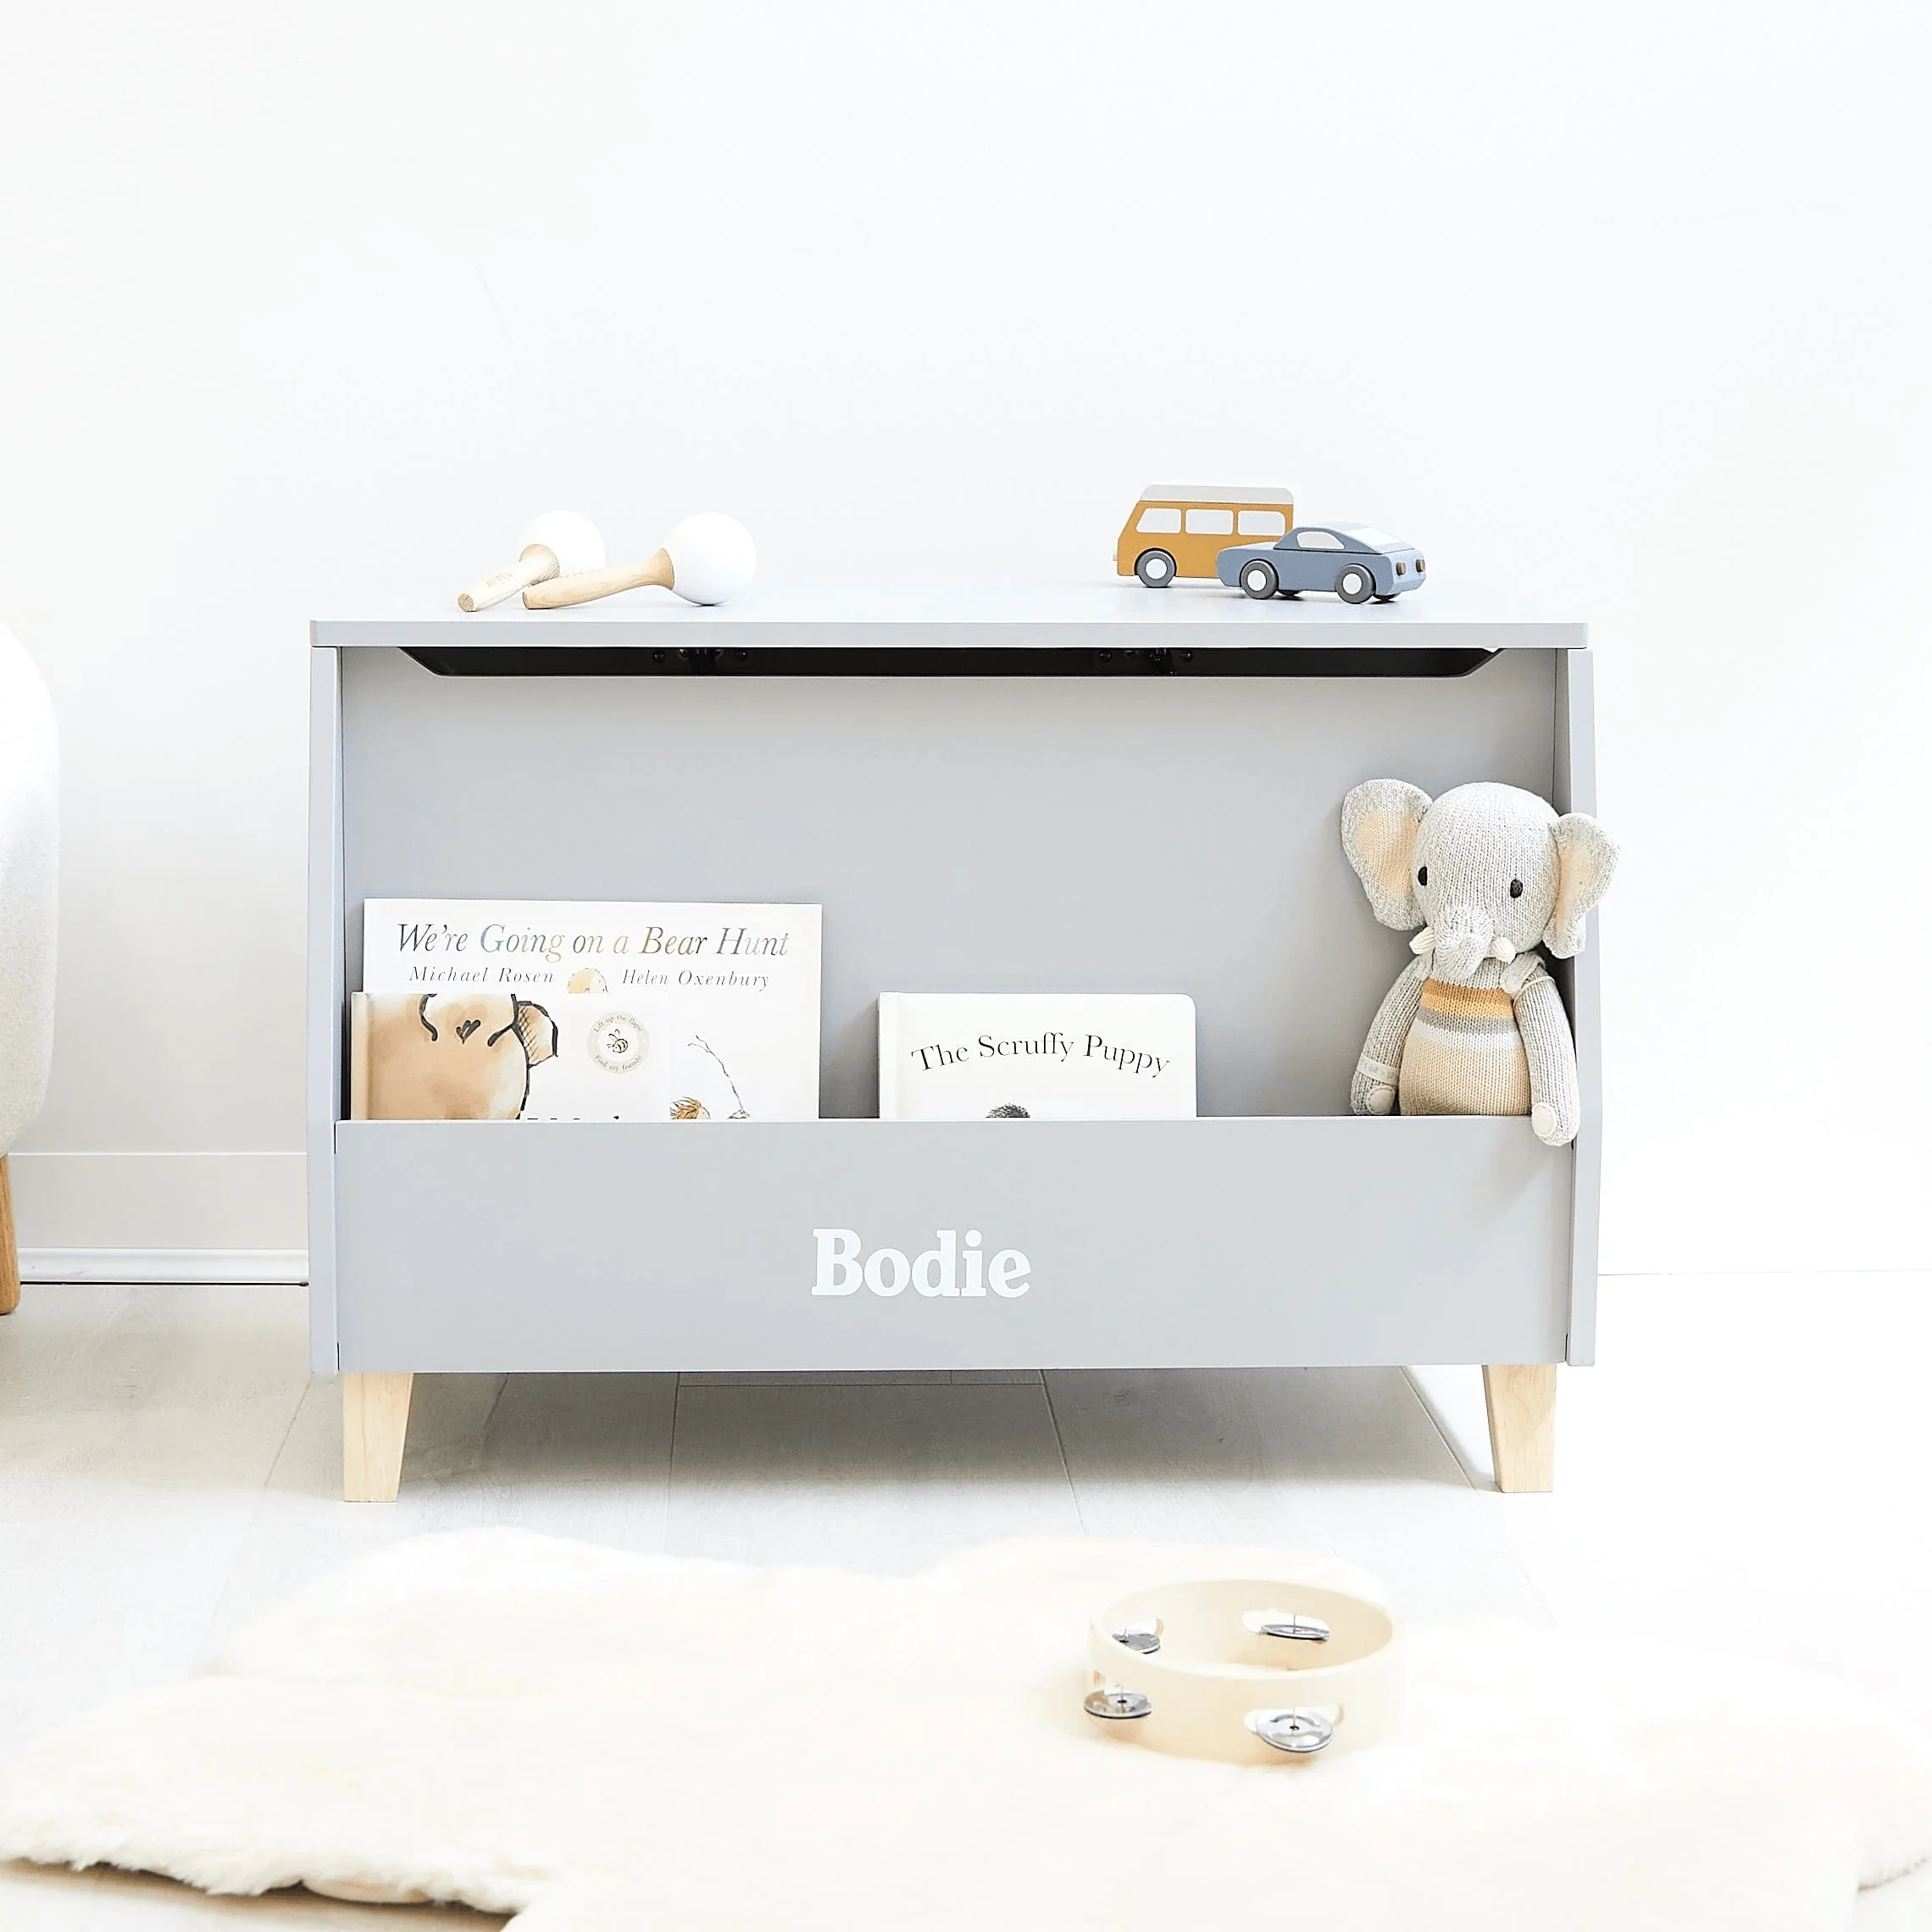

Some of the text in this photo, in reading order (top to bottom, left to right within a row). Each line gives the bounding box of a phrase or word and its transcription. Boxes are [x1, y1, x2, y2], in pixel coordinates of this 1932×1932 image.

[397, 923, 789, 963] We're Going on a Bear Hunt
[408, 966, 553, 984] Michael Rosen
[622, 969, 769, 992] Helen Oxenbury
[910, 1031, 1170, 1079] The Scruffy Puppy
[811, 1228, 1031, 1298] Bodie
